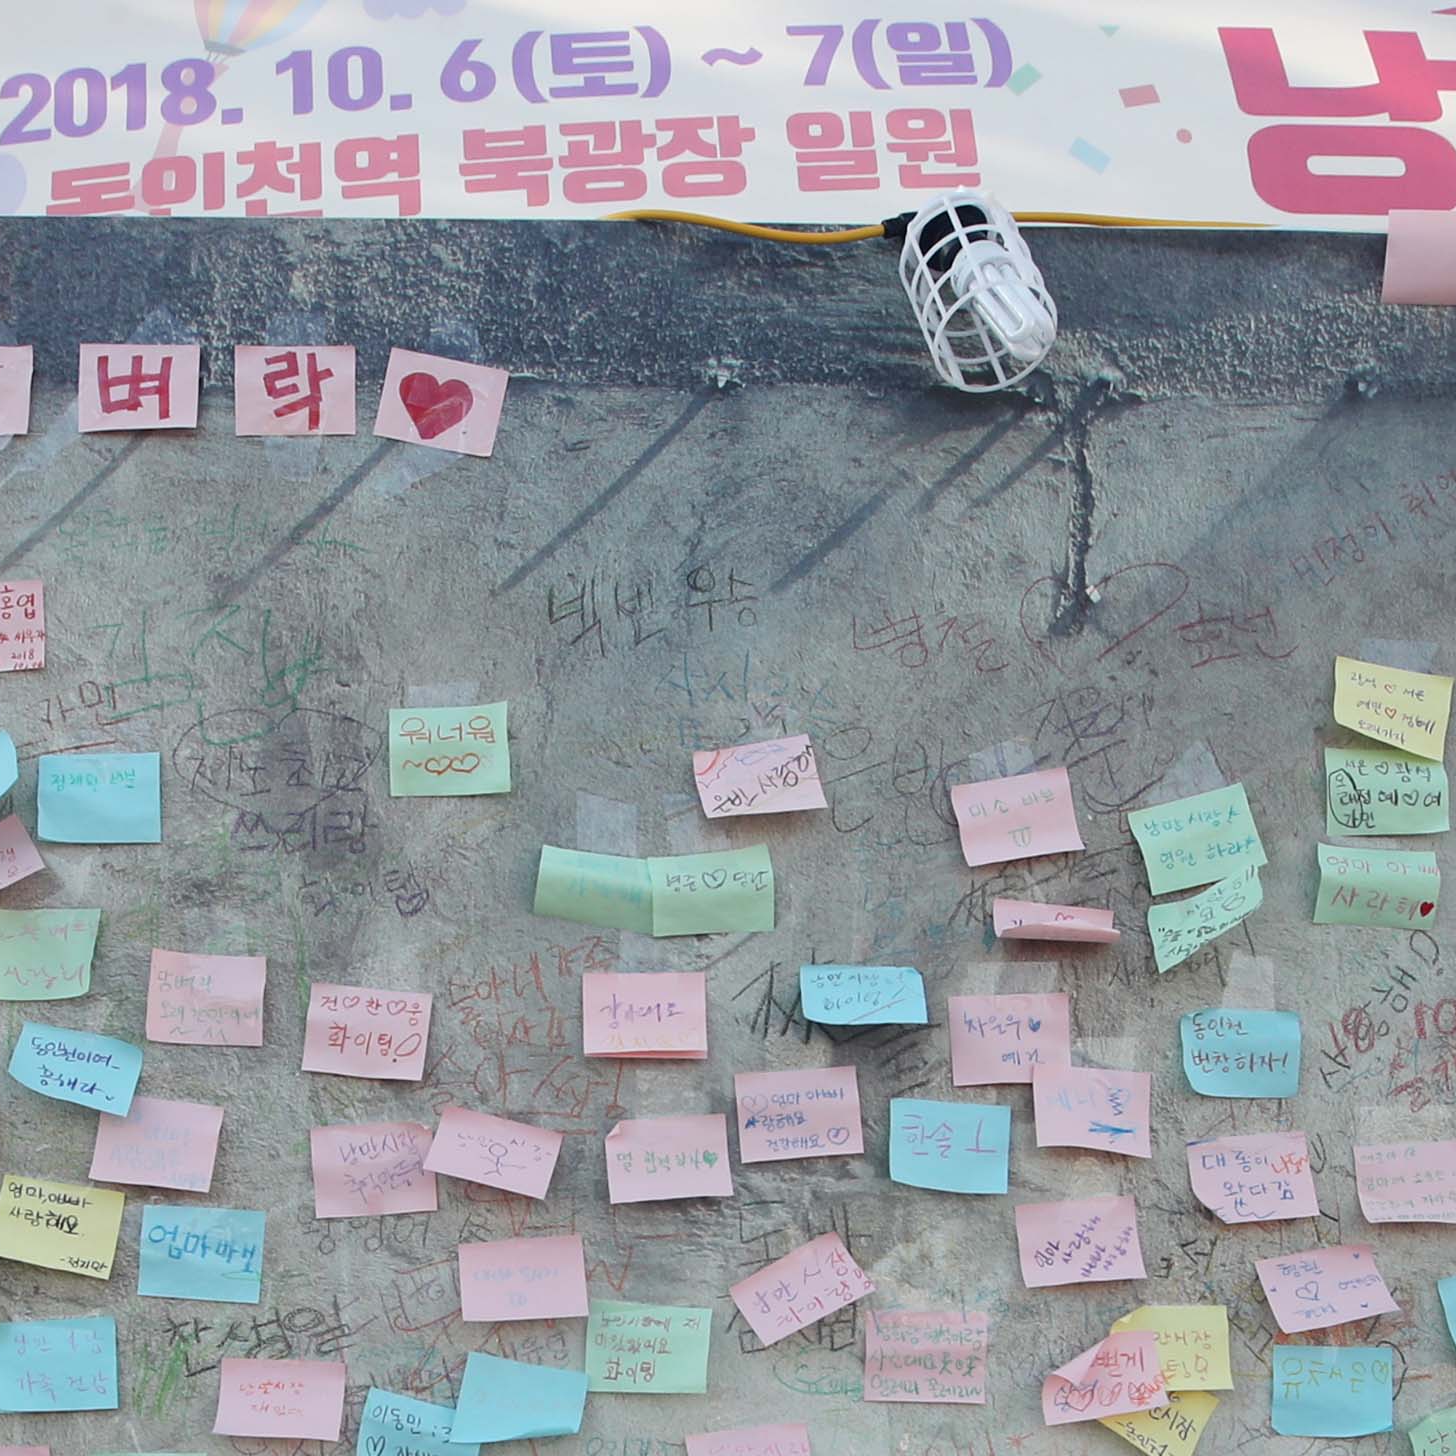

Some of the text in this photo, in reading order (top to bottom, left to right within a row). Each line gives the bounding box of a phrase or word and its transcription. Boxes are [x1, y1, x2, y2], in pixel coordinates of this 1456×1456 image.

[0, 58, 243, 146] 2018.
[275, 46, 412, 116] 10.
[440, 26, 672, 103] 6(토)
[786, 18, 1013, 90] 7(일)
[459, 115, 755, 207] 북광장
[786, 109, 981, 192] 일원
[401, 717, 496, 742] 워너원
[1331, 888, 1417, 916] 사랑해
[1192, 1013, 1248, 1040] 동인천
[1193, 1050, 1289, 1072] 번창하자!
[371, 1406, 421, 1432] 이동민
